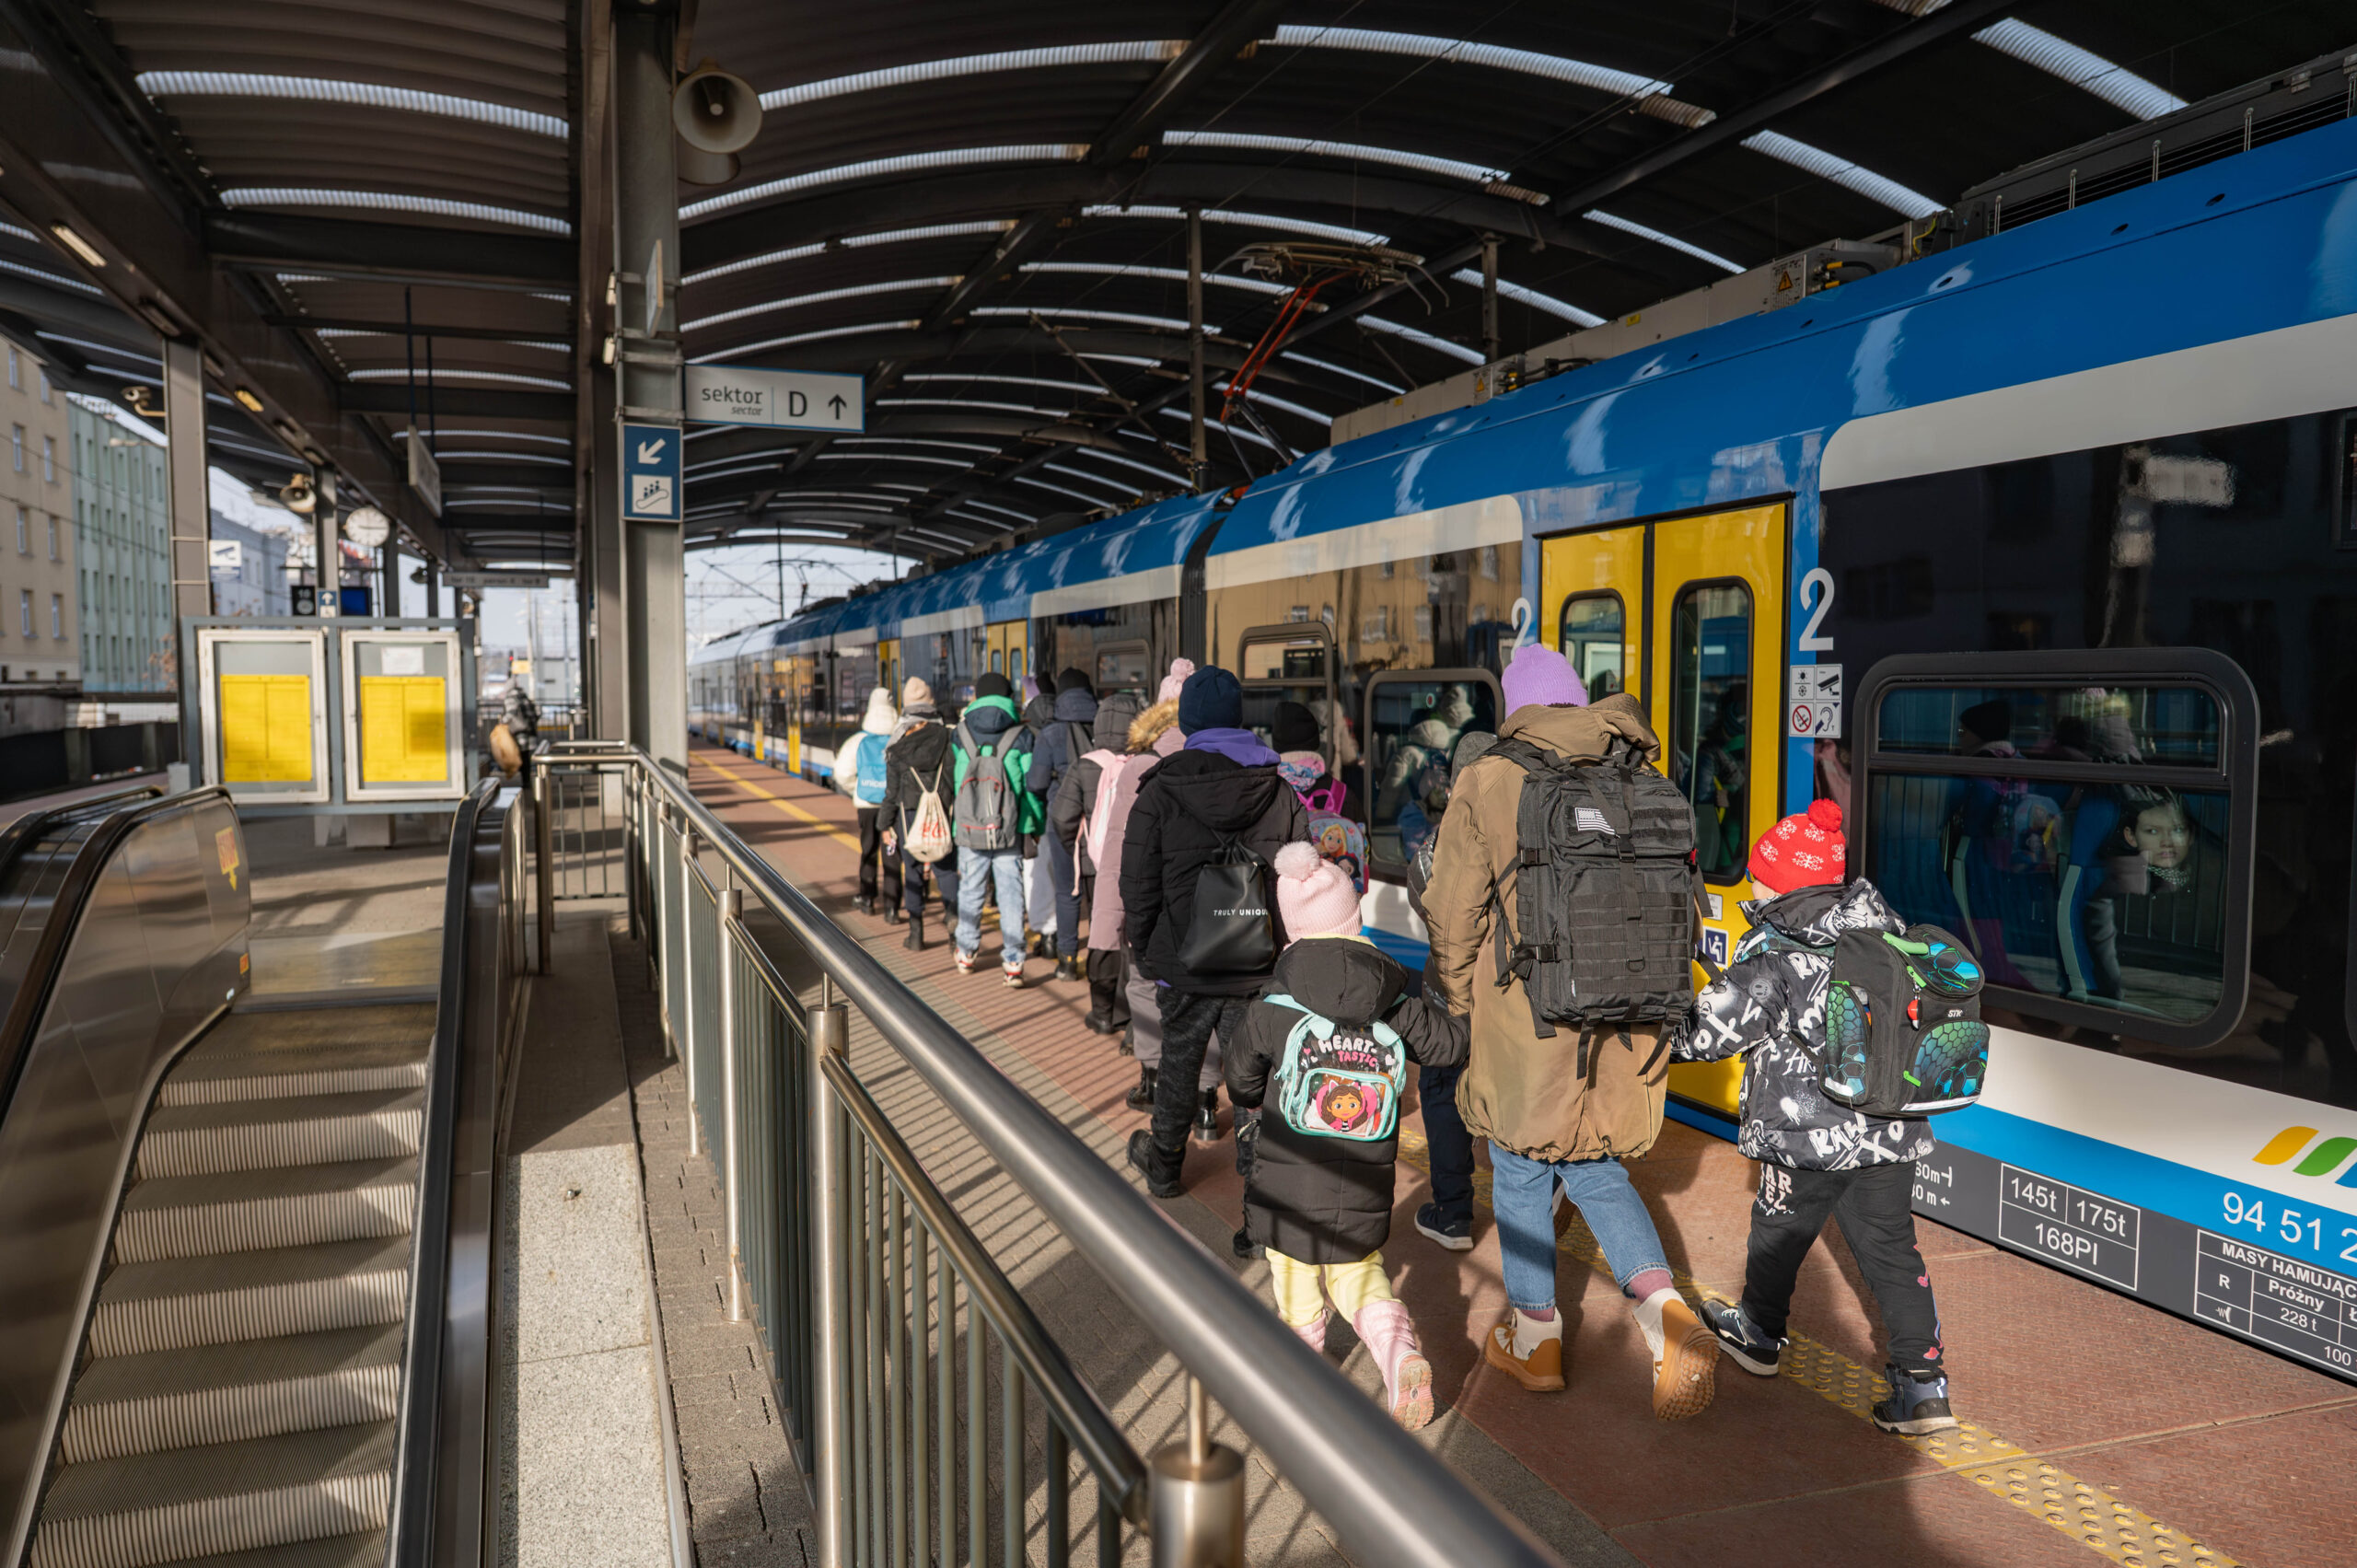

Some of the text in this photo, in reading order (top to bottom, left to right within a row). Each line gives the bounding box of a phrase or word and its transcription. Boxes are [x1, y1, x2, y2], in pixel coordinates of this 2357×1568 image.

[702, 386, 807, 417] sektor D
[731, 406, 762, 416] sector
[1799, 567, 1835, 652] 2
[1511, 598, 1532, 661] 2
[1213, 909, 1236, 917] TRULY
[1947, 1009, 1964, 1018] STK
[1318, 1034, 1377, 1054] HEART-
[1337, 1050, 1378, 1067] TASTIC
[1760, 1162, 1793, 1194] AR
[1760, 1179, 1787, 1211] EL
[1926, 1191, 1937, 1207] m
[2011, 1177, 2126, 1237] 145t 175t
[2223, 1191, 2357, 1263] 94 51 2
[2223, 1241, 2269, 1269] MASY
[2219, 1273, 2231, 1290] R
[2269, 1279, 2325, 1312] Próżny
[2280, 1307, 2317, 1332] 228 t
[2324, 1345, 2351, 1366] 100
